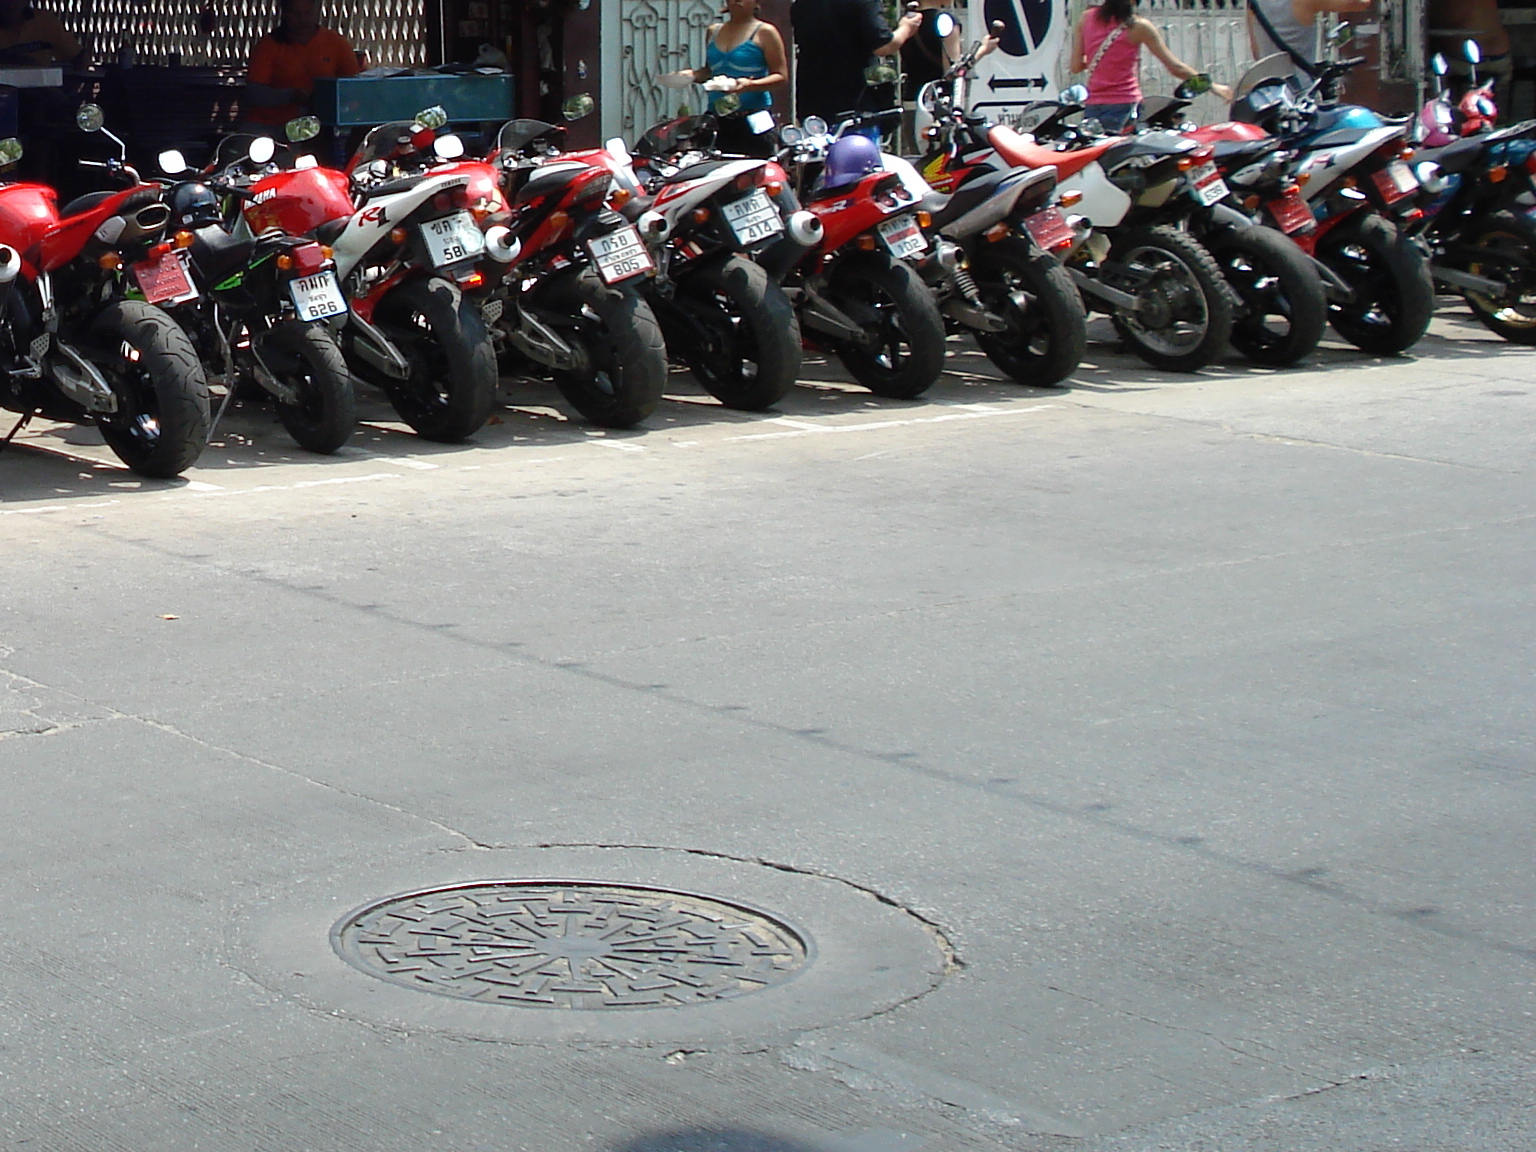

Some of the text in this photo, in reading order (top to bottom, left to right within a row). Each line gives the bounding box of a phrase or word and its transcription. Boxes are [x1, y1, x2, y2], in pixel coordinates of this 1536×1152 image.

[358, 206, 391, 229] R1
[749, 221, 773, 238] 414
[897, 238, 922, 253] 102
[613, 259, 640, 276] 805
[308, 301, 338, 318] 626
